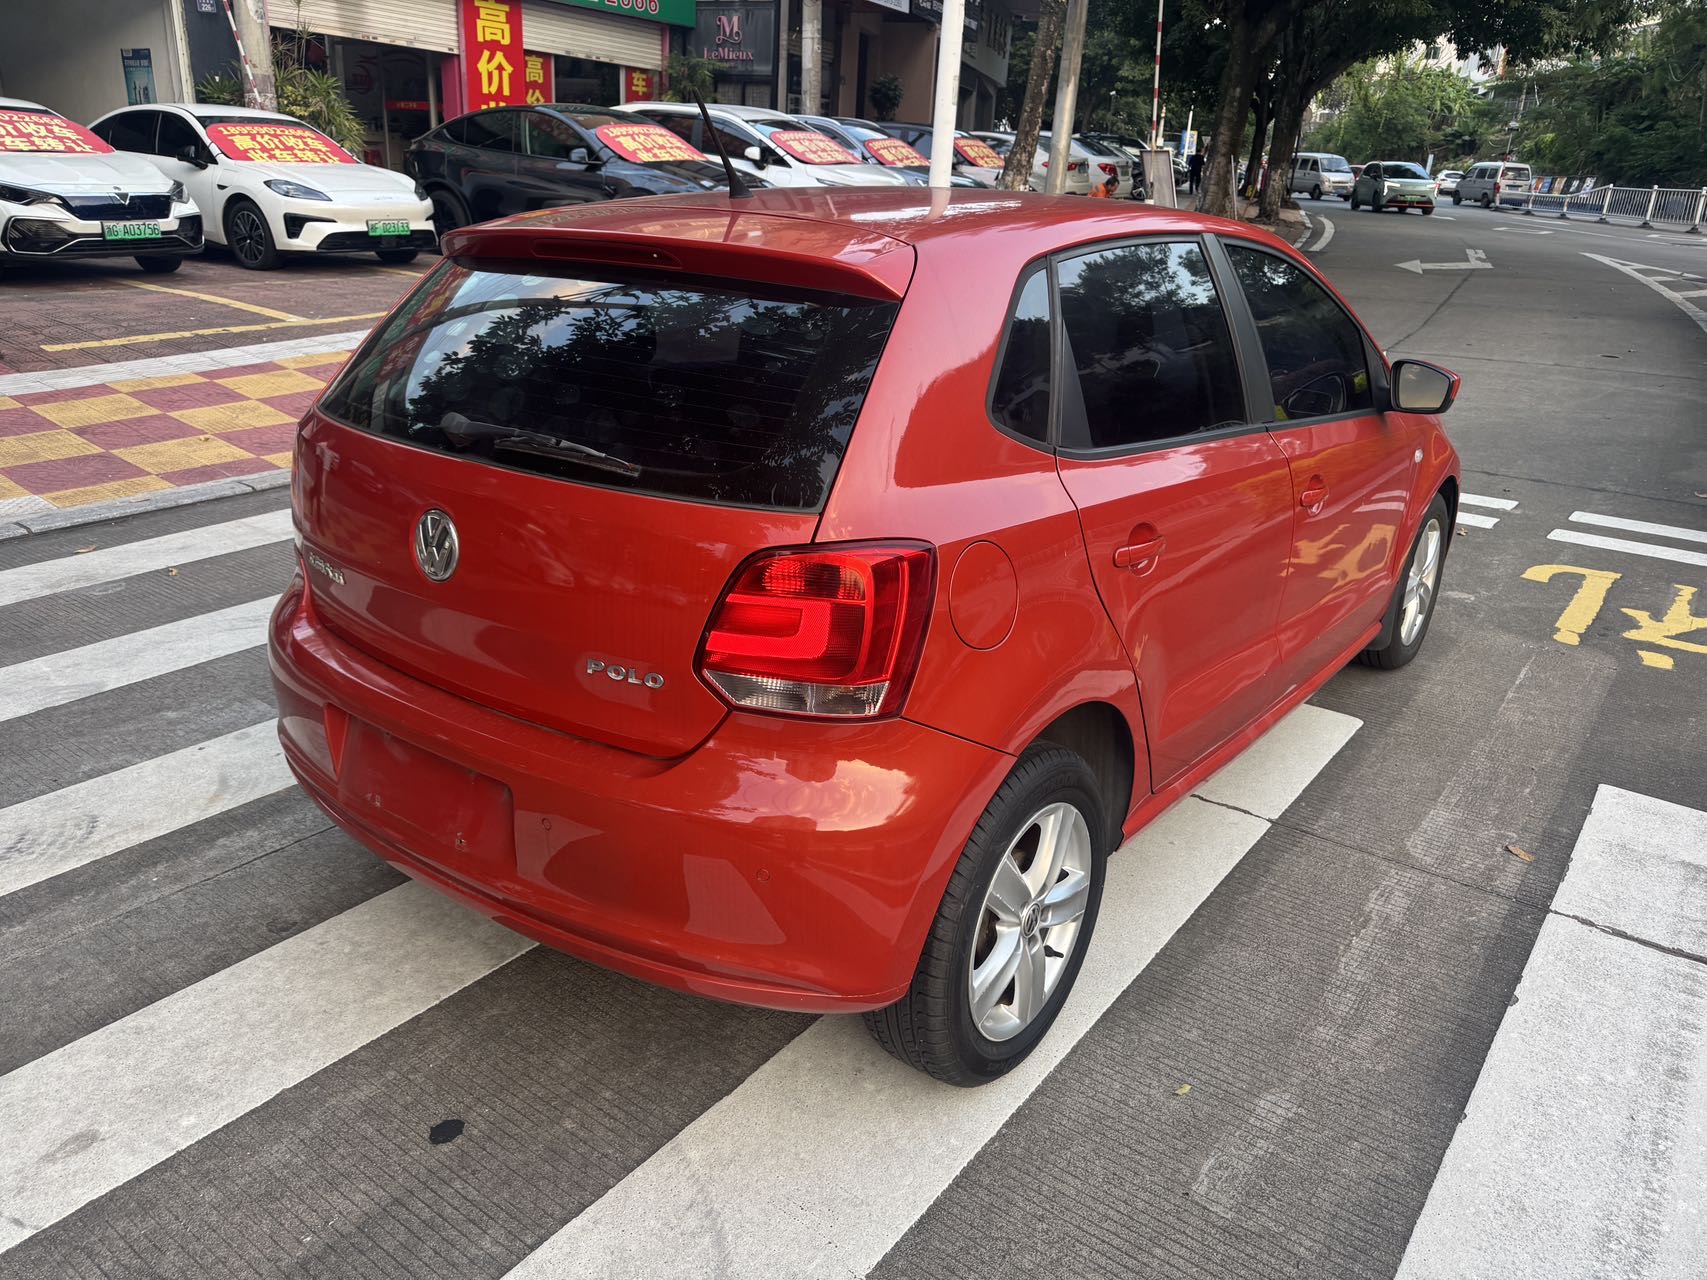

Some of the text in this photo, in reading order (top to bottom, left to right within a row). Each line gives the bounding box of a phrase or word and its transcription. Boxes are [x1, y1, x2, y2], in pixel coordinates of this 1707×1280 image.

[716, 15, 742, 44] M
[474, 0, 513, 110] 高价
[704, 47, 753, 60] LeMieux
[632, 71, 648, 96] 车
[0, 135, 102, 154] 车转让
[227, 134, 331, 151] 高价收车
[586, 659, 665, 689] POLO
